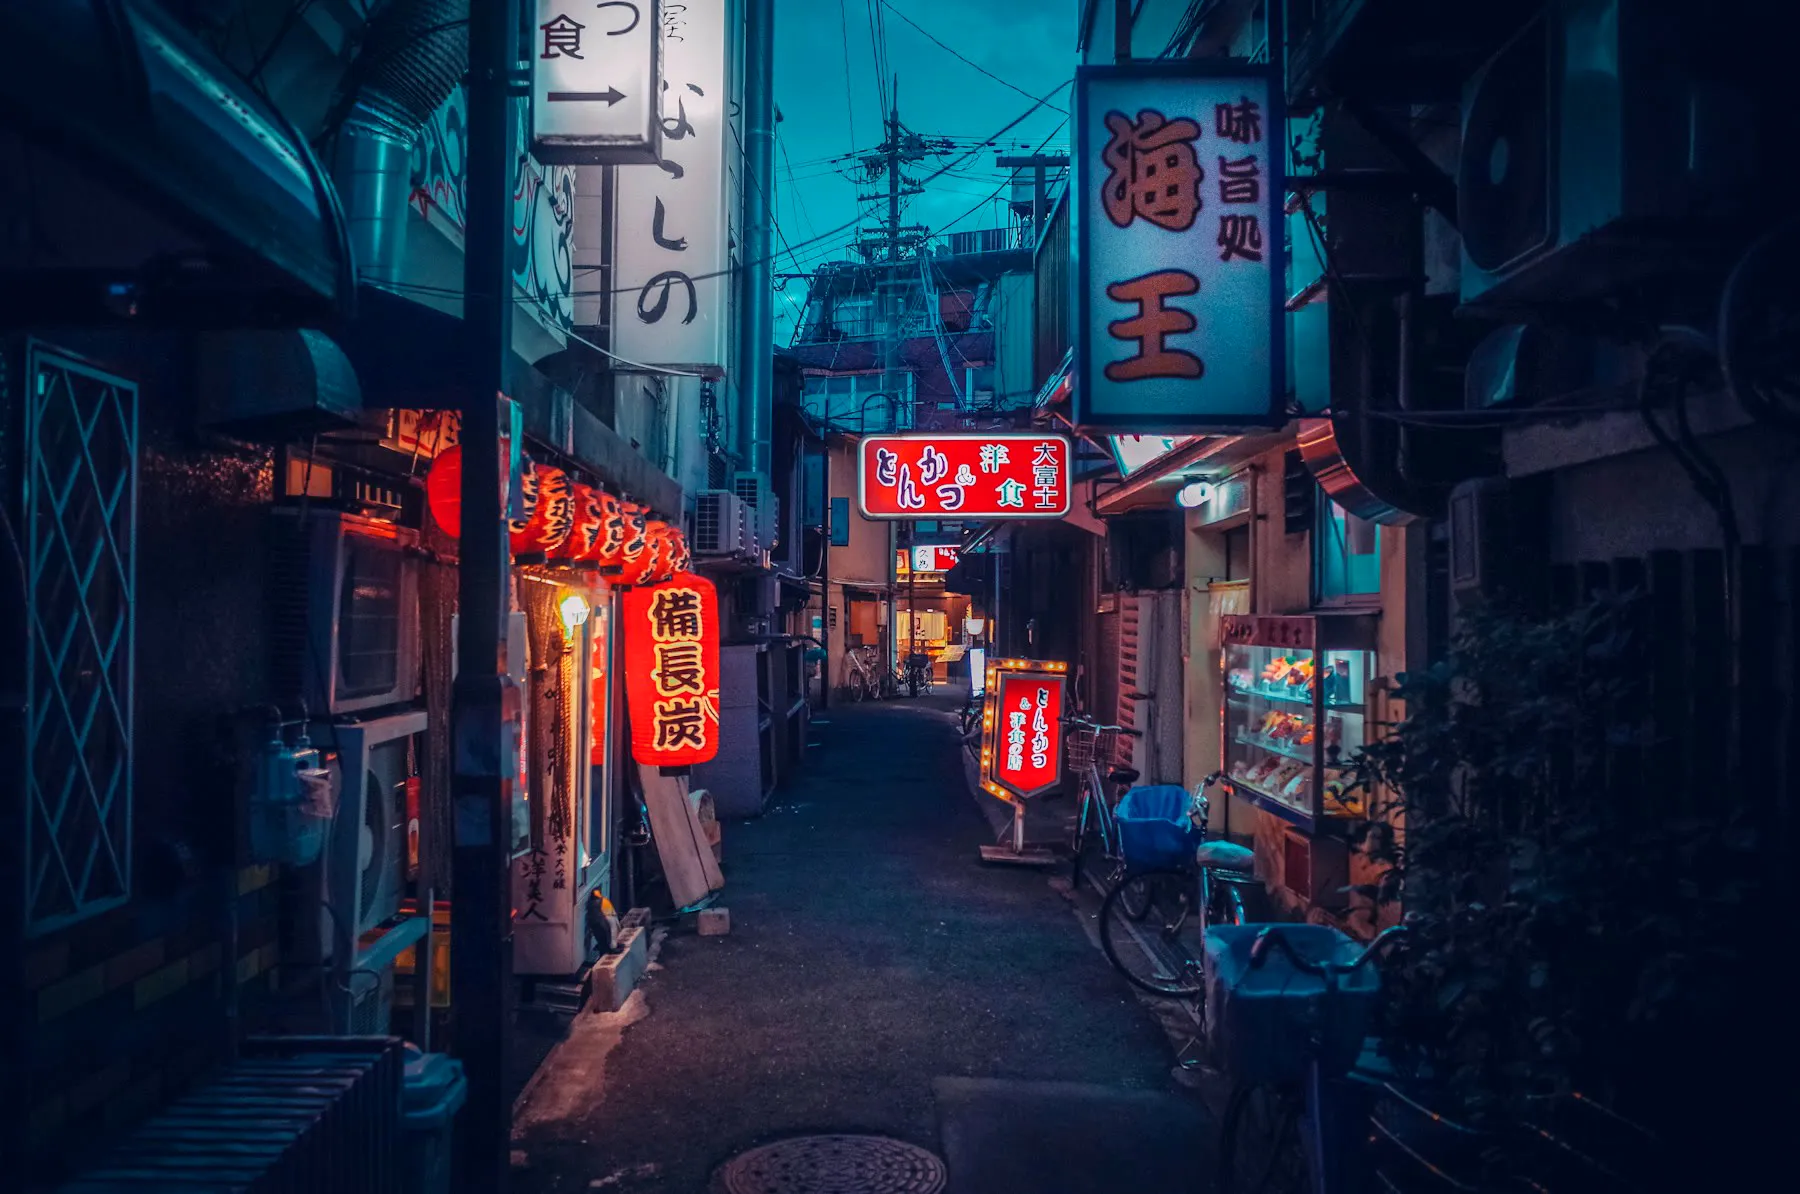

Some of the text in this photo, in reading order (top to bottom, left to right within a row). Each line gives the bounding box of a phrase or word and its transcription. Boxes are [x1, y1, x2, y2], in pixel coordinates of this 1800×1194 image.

[540, 14, 586, 60] 食
[1215, 96, 1263, 263] 味旨処
[1101, 107, 1205, 382] 海王
[1032, 443, 1059, 509] 大富士
[651, 588, 705, 751] 備長炭
[1031, 687, 1049, 769] とんかつ
